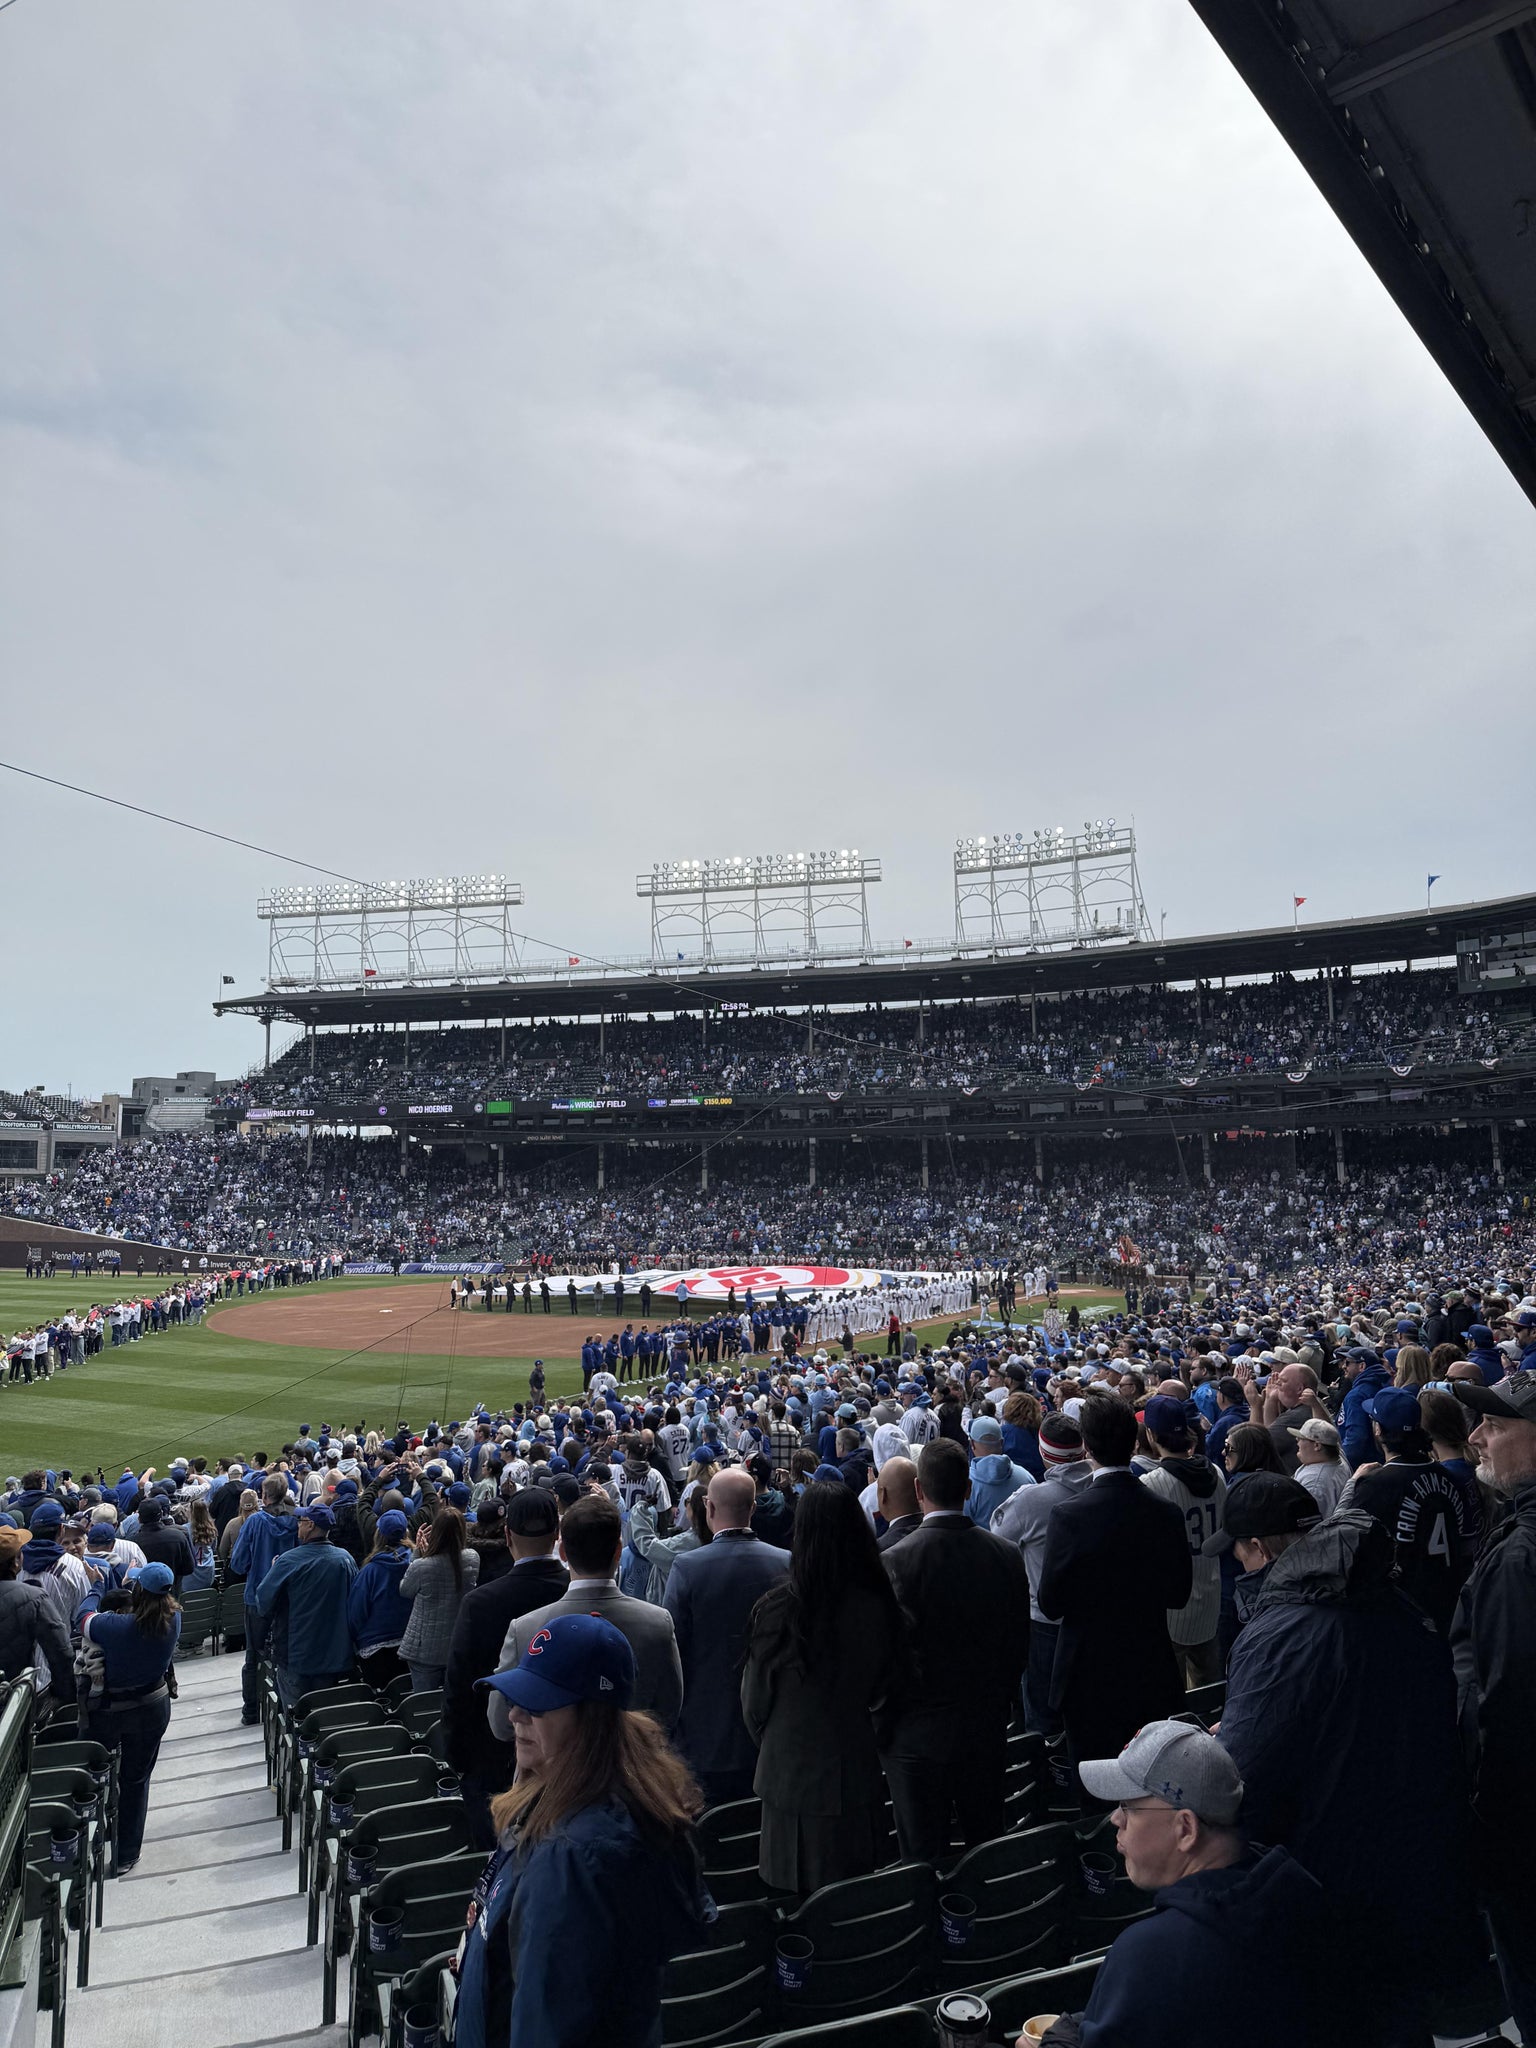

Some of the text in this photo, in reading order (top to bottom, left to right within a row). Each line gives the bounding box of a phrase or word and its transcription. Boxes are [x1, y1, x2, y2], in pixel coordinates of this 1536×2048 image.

[574, 1100, 606, 1109] WRIGLEY
[606, 1100, 627, 1108] FIELD
[703, 1097, 733, 1106] $150,000
[267, 1109, 296, 1117] WRIGLEY
[296, 1109, 315, 1117] FIELD
[408, 1104, 453, 1114] NICO HOERNER
[210, 1260, 231, 1268] Invesc
[421, 1262, 483, 1274] Reynolds Wrap
[672, 1438, 687, 1455] 27
[1428, 1512, 1450, 1567] 4
[527, 1628, 552, 1656] C
